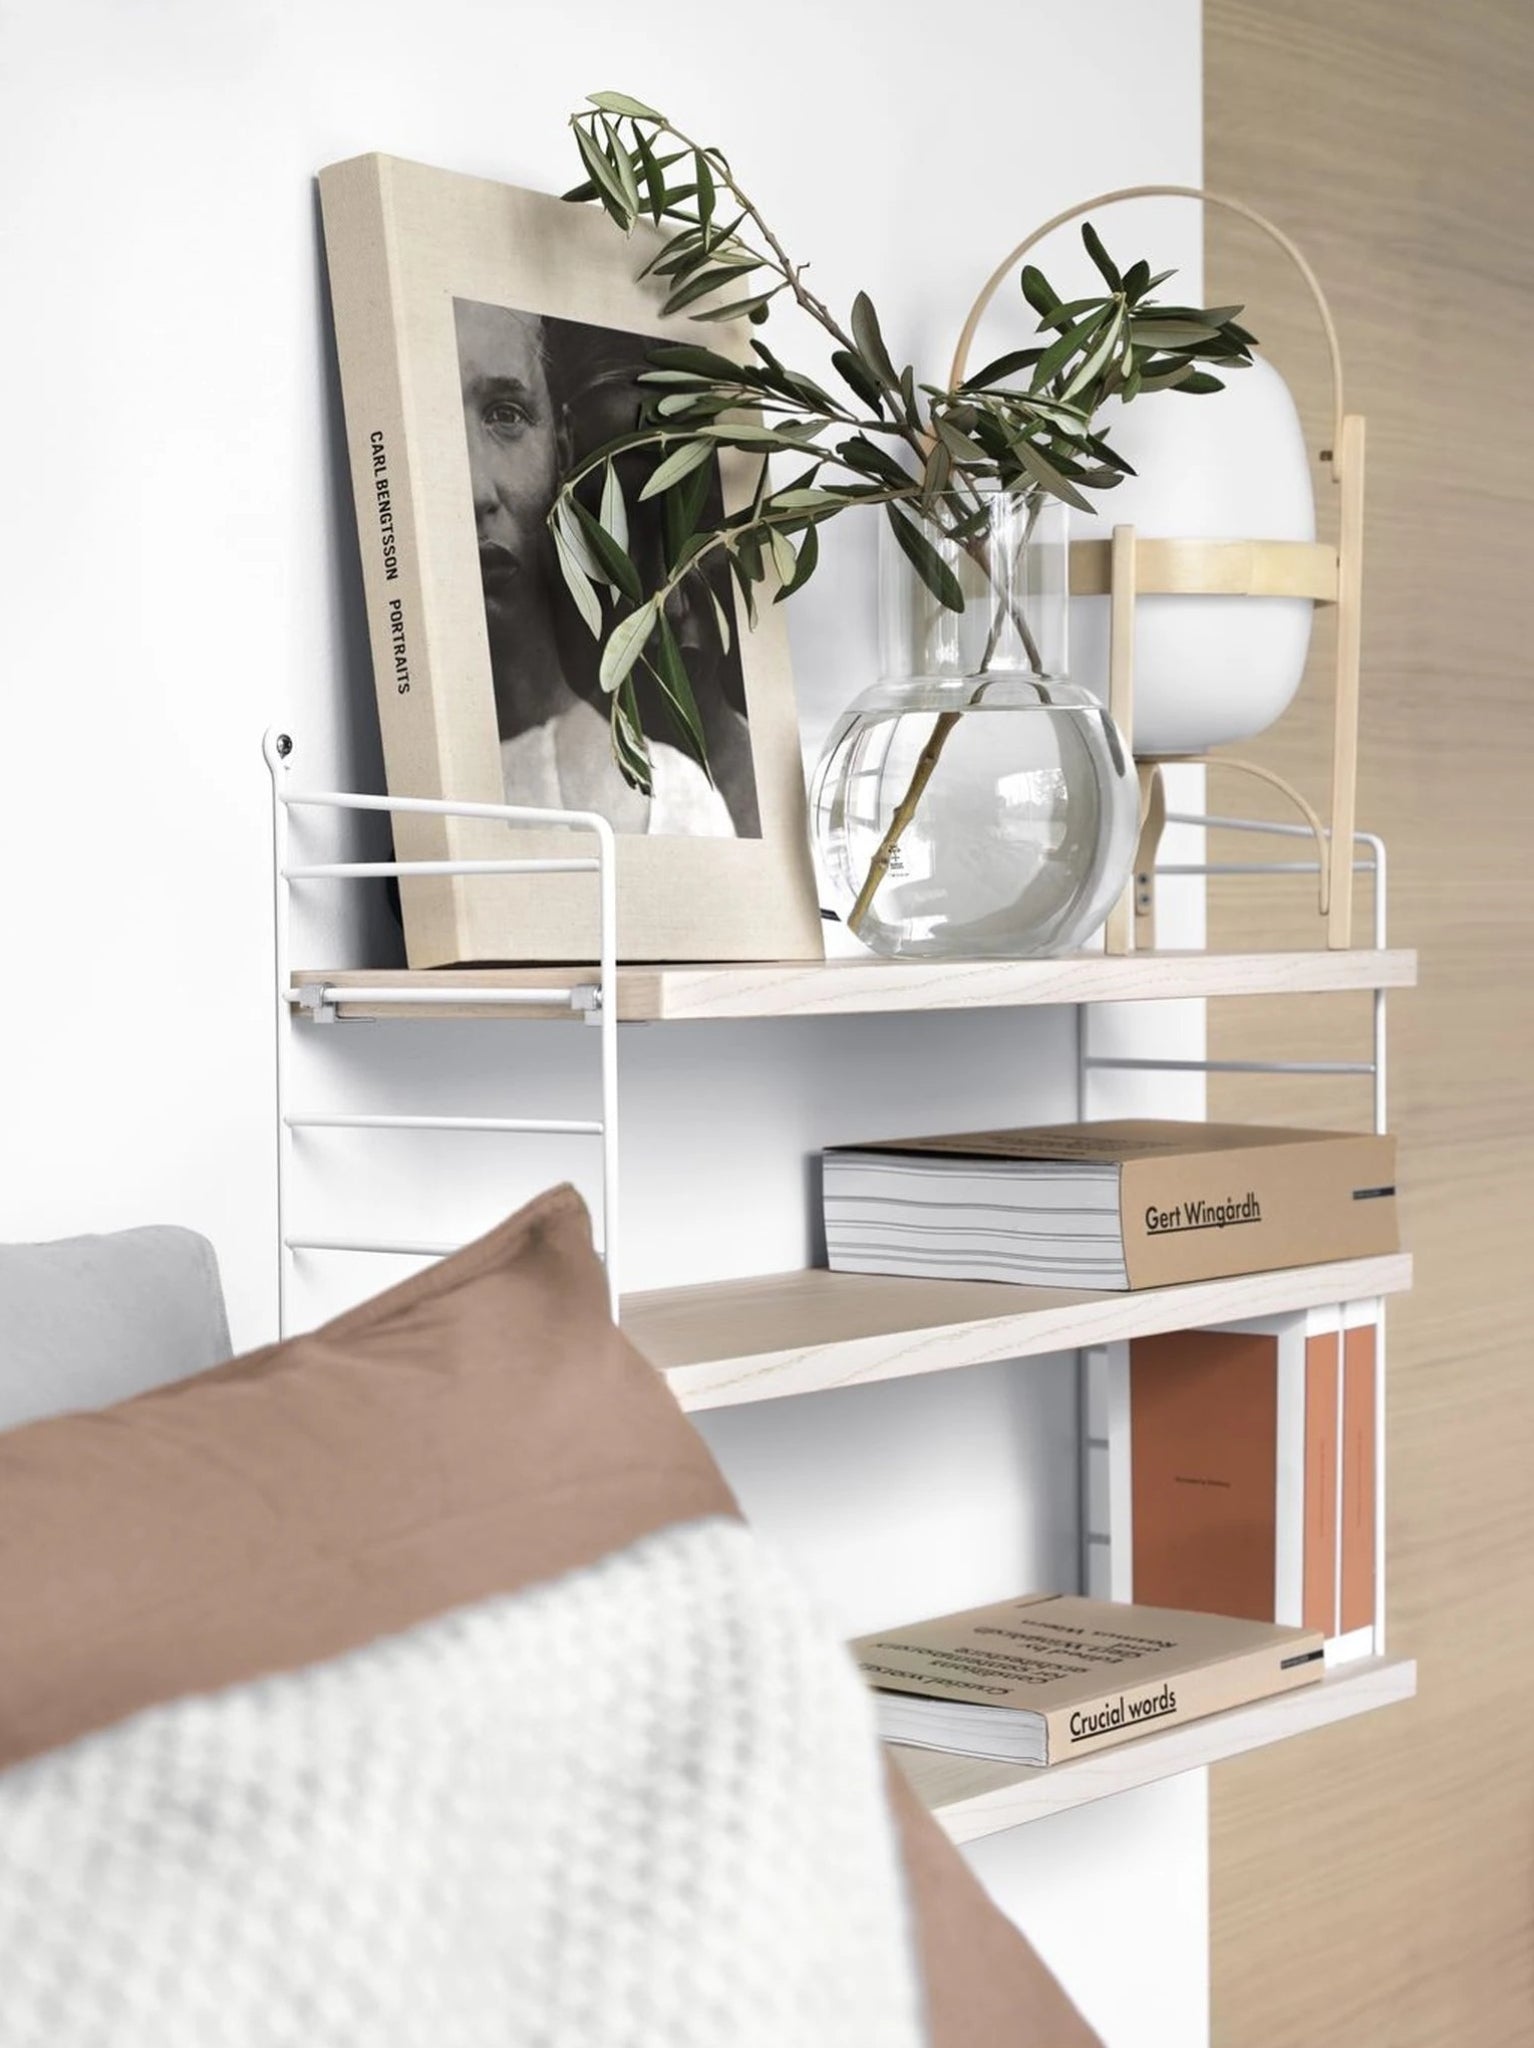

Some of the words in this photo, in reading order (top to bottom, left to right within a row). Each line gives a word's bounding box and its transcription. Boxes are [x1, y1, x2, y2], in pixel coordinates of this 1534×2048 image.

[370, 431, 388, 477] CARL
[375, 478, 399, 581] BENGTSSON
[389, 599, 411, 695] PORTRAITS
[1145, 1206, 1181, 1230] Gert
[1184, 1192, 1261, 1229] Wingårdh
[1070, 1698, 1125, 1736] Crucial
[1129, 1684, 1177, 1719] words
